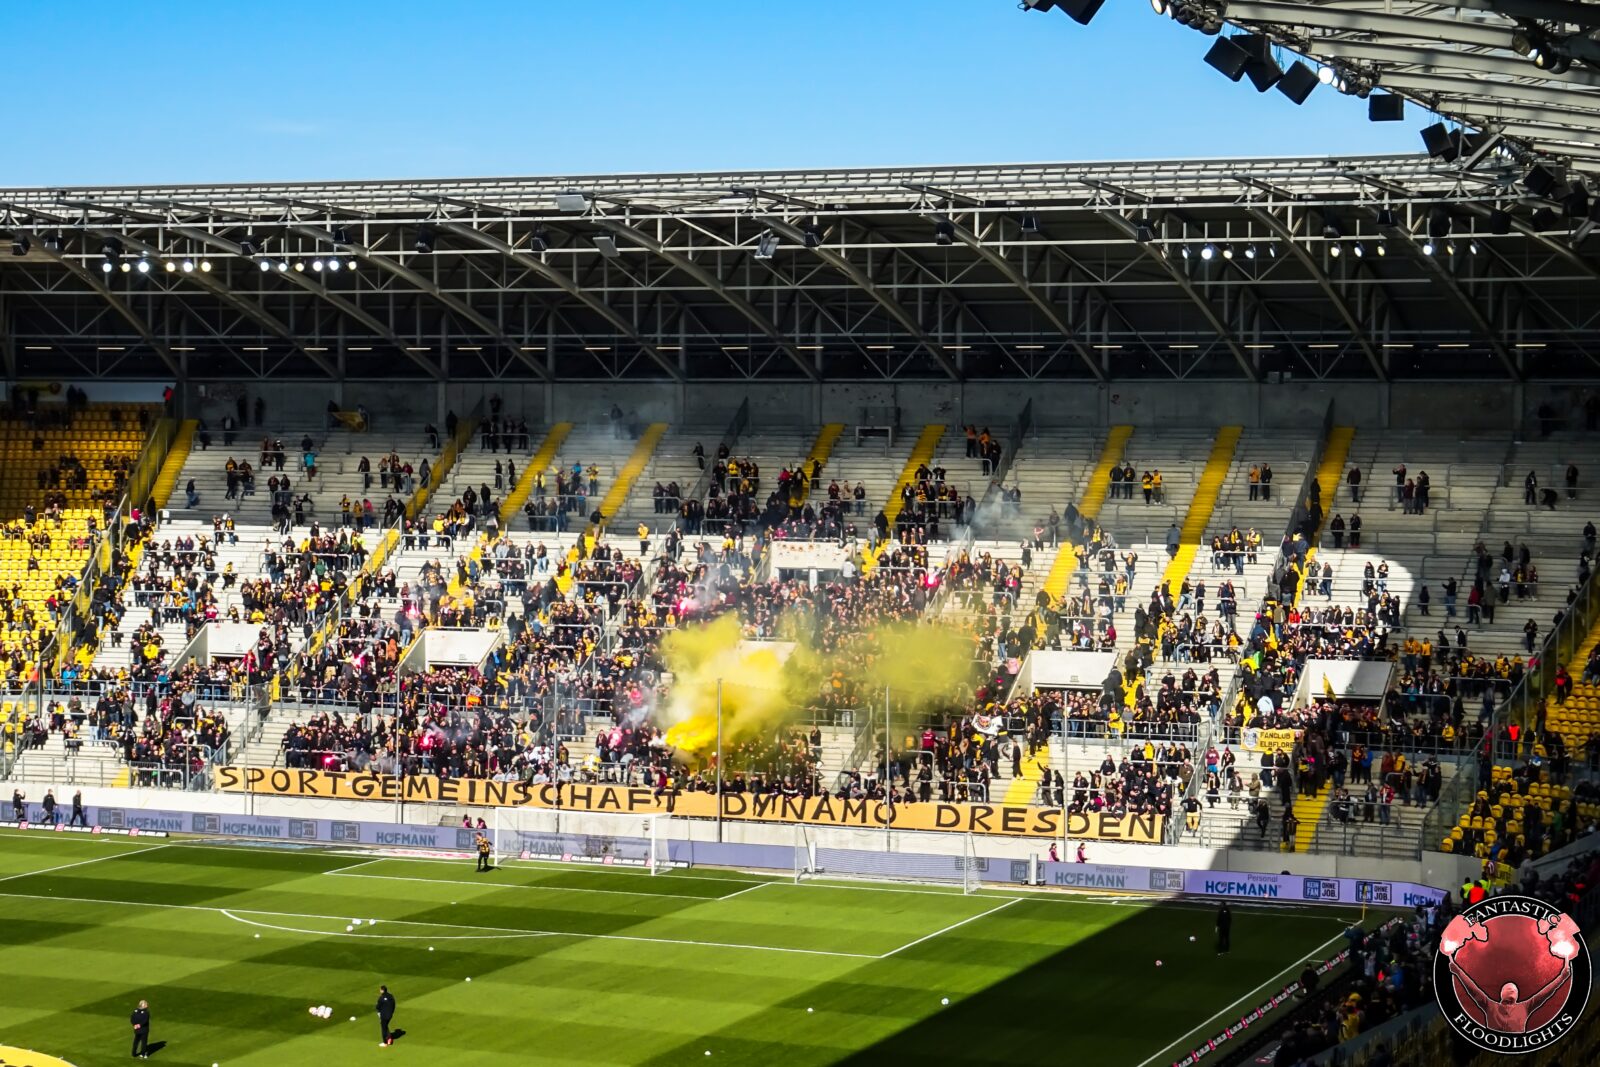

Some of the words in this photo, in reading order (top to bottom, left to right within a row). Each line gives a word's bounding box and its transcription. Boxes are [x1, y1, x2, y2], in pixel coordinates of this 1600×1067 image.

[1260, 731, 1291, 740] FANCLUB
[219, 766, 682, 812] SPORTGEMEINSCHAFT
[723, 792, 897, 825] DYNAMO
[936, 803, 1156, 840] DRESDEN
[127, 816, 182, 831] HOFMANN
[223, 822, 281, 836] HOFMANN
[376, 831, 437, 846] HOFMANN
[1055, 871, 1125, 888] HOFMANN
[1247, 873, 1278, 883] Personal
[1205, 880, 1278, 897] HOFMANN
[1374, 885, 1388, 893] OHNE
